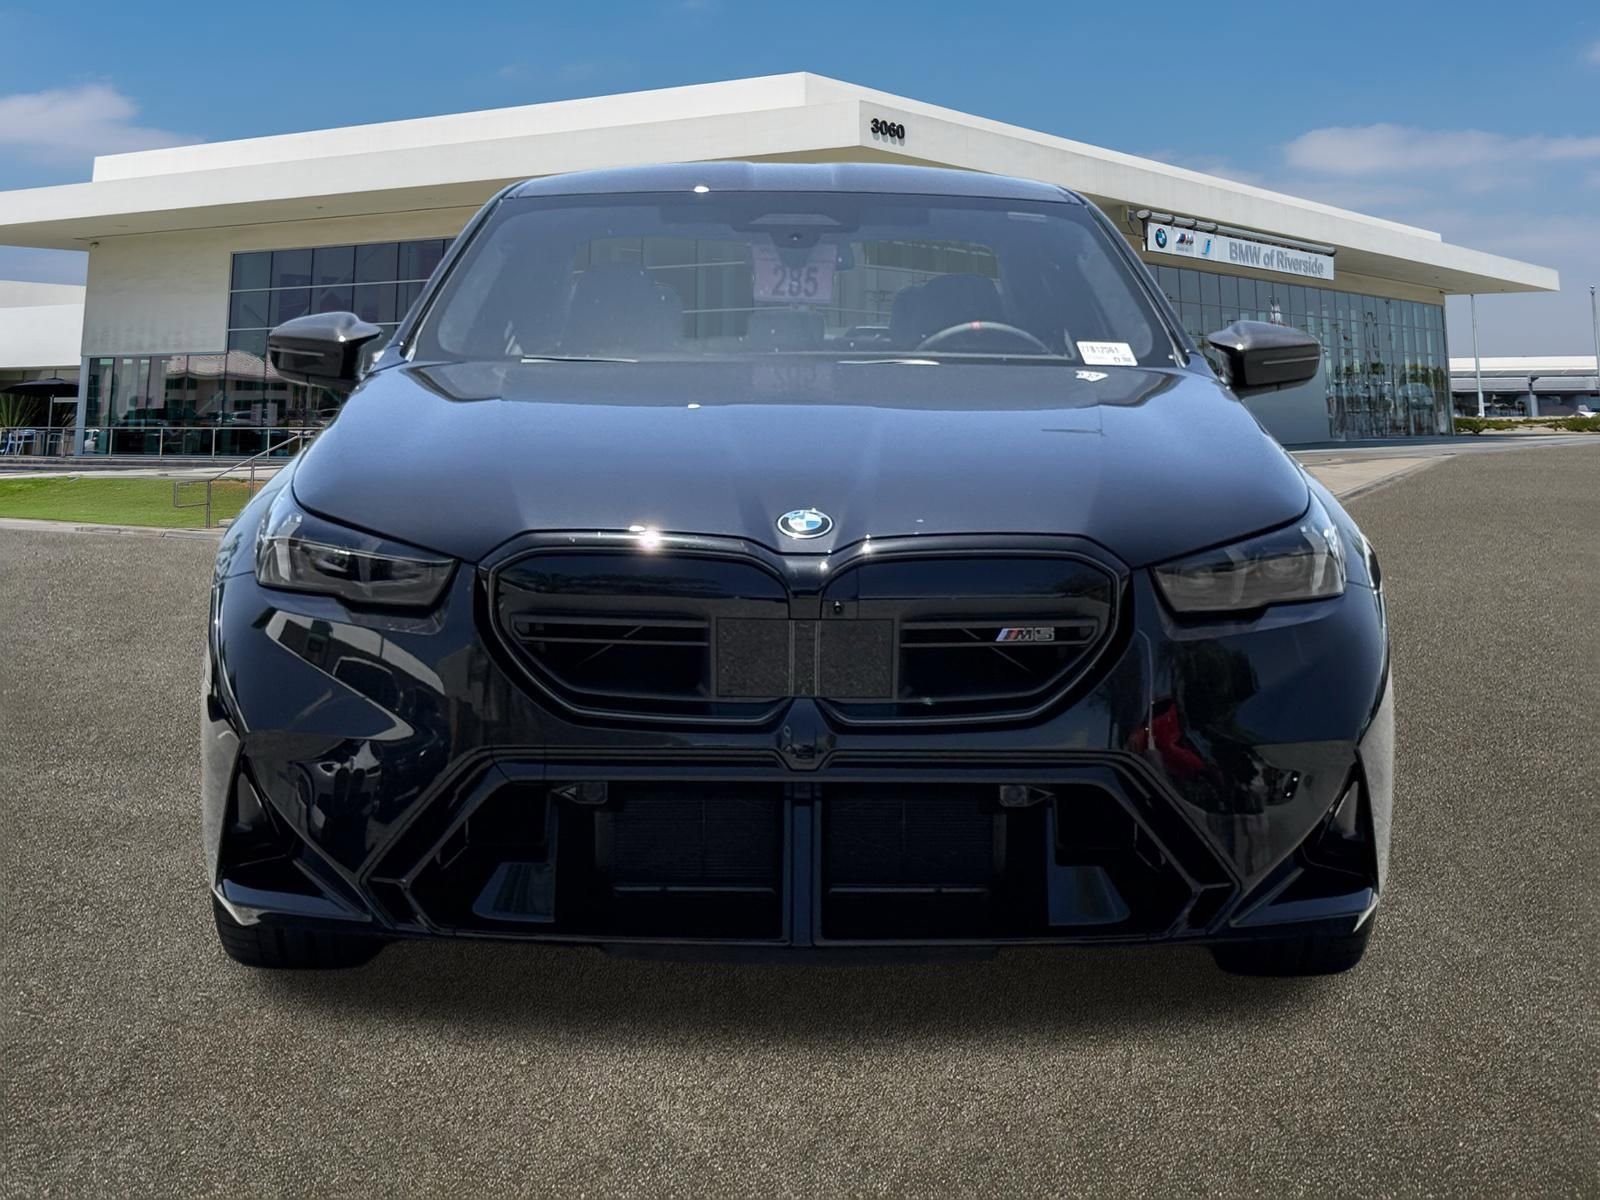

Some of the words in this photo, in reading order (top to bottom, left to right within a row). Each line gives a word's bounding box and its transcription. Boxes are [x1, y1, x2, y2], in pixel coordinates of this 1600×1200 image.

[870, 117, 905, 140] 3060
[1229, 241, 1261, 265] BMW
[1263, 249, 1275, 268] of
[1276, 250, 1324, 275] Riverside
[771, 265, 819, 297] 285
[1013, 627, 1055, 641] M5
